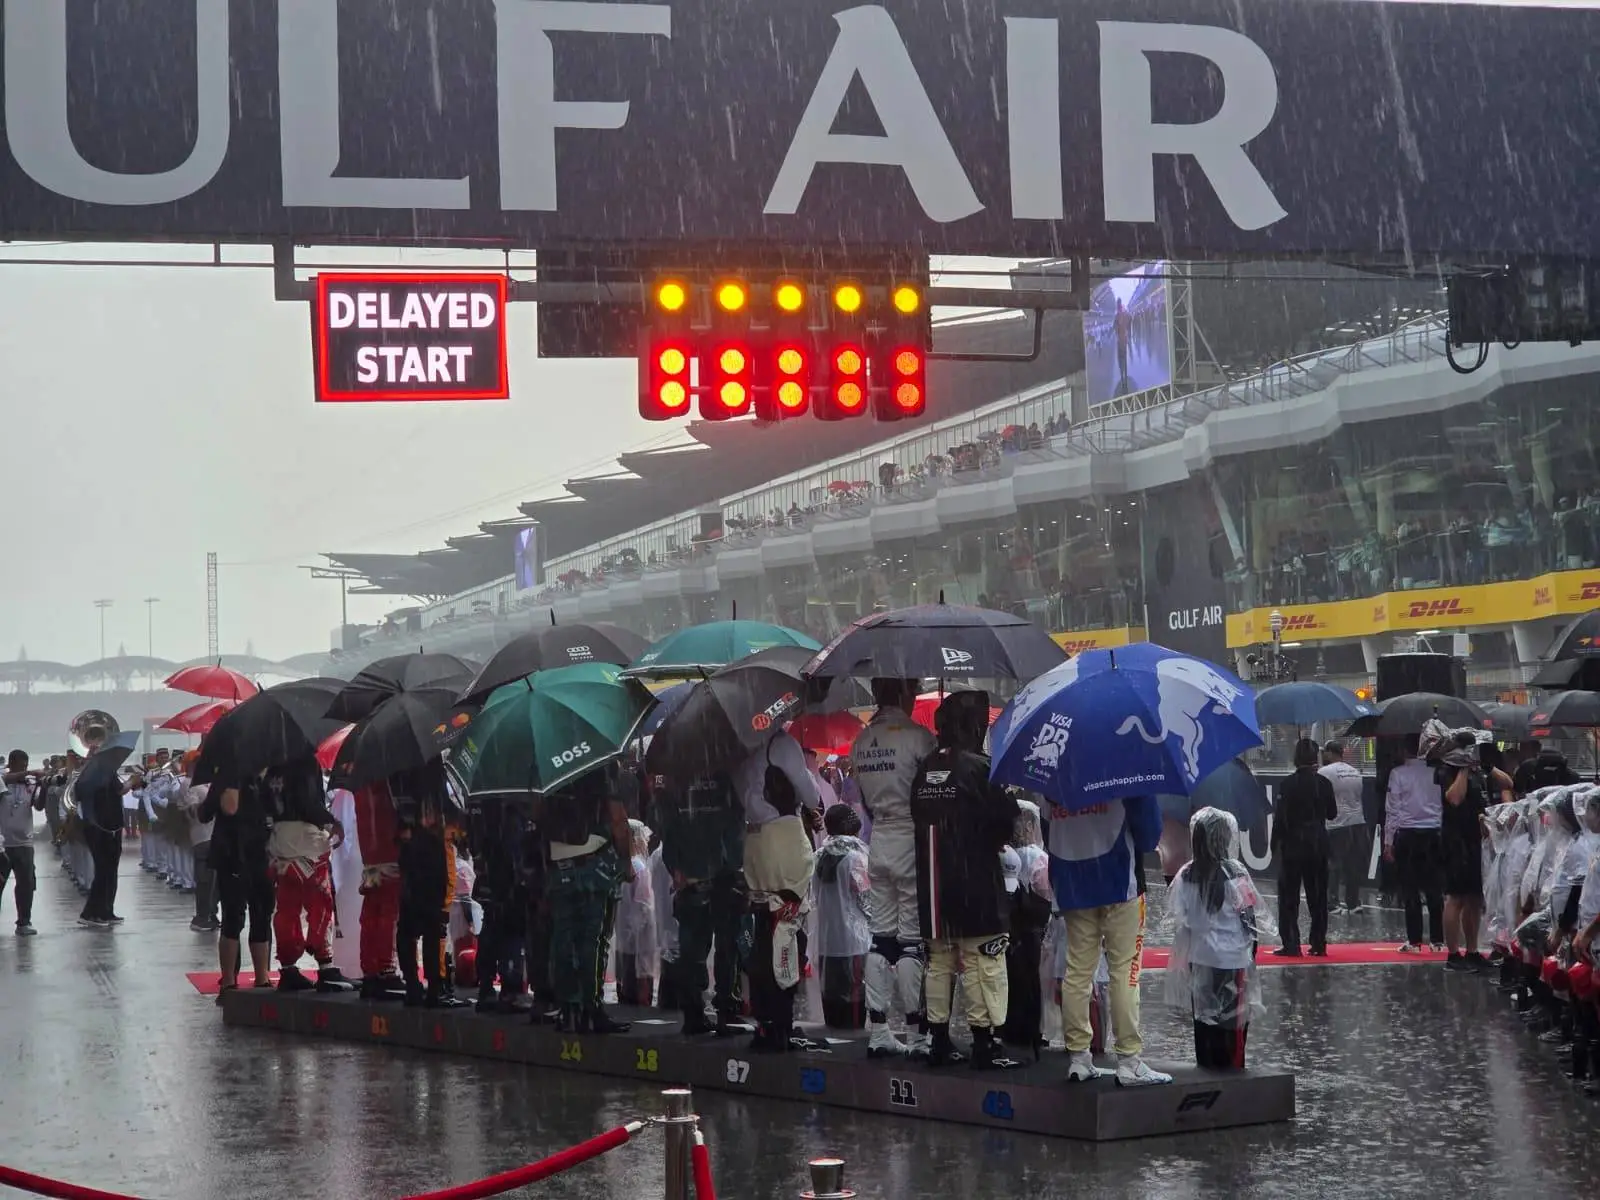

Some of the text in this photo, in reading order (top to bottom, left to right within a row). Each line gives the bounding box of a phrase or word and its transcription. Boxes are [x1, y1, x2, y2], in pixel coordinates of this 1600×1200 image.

[763, 3, 1289, 231] AIR
[329, 292, 496, 329] DELAYED
[356, 346, 472, 383] START
[1168, 605, 1223, 630] GULF AIR
[1409, 598, 1464, 617] DHL
[1050, 712, 1073, 728] VISA
[551, 741, 591, 769] BOSS
[1083, 774, 1165, 792] visacashapprb.com
[636, 1048, 658, 1072] 18
[726, 1059, 750, 1083] 87
[890, 1077, 919, 1107] 11
